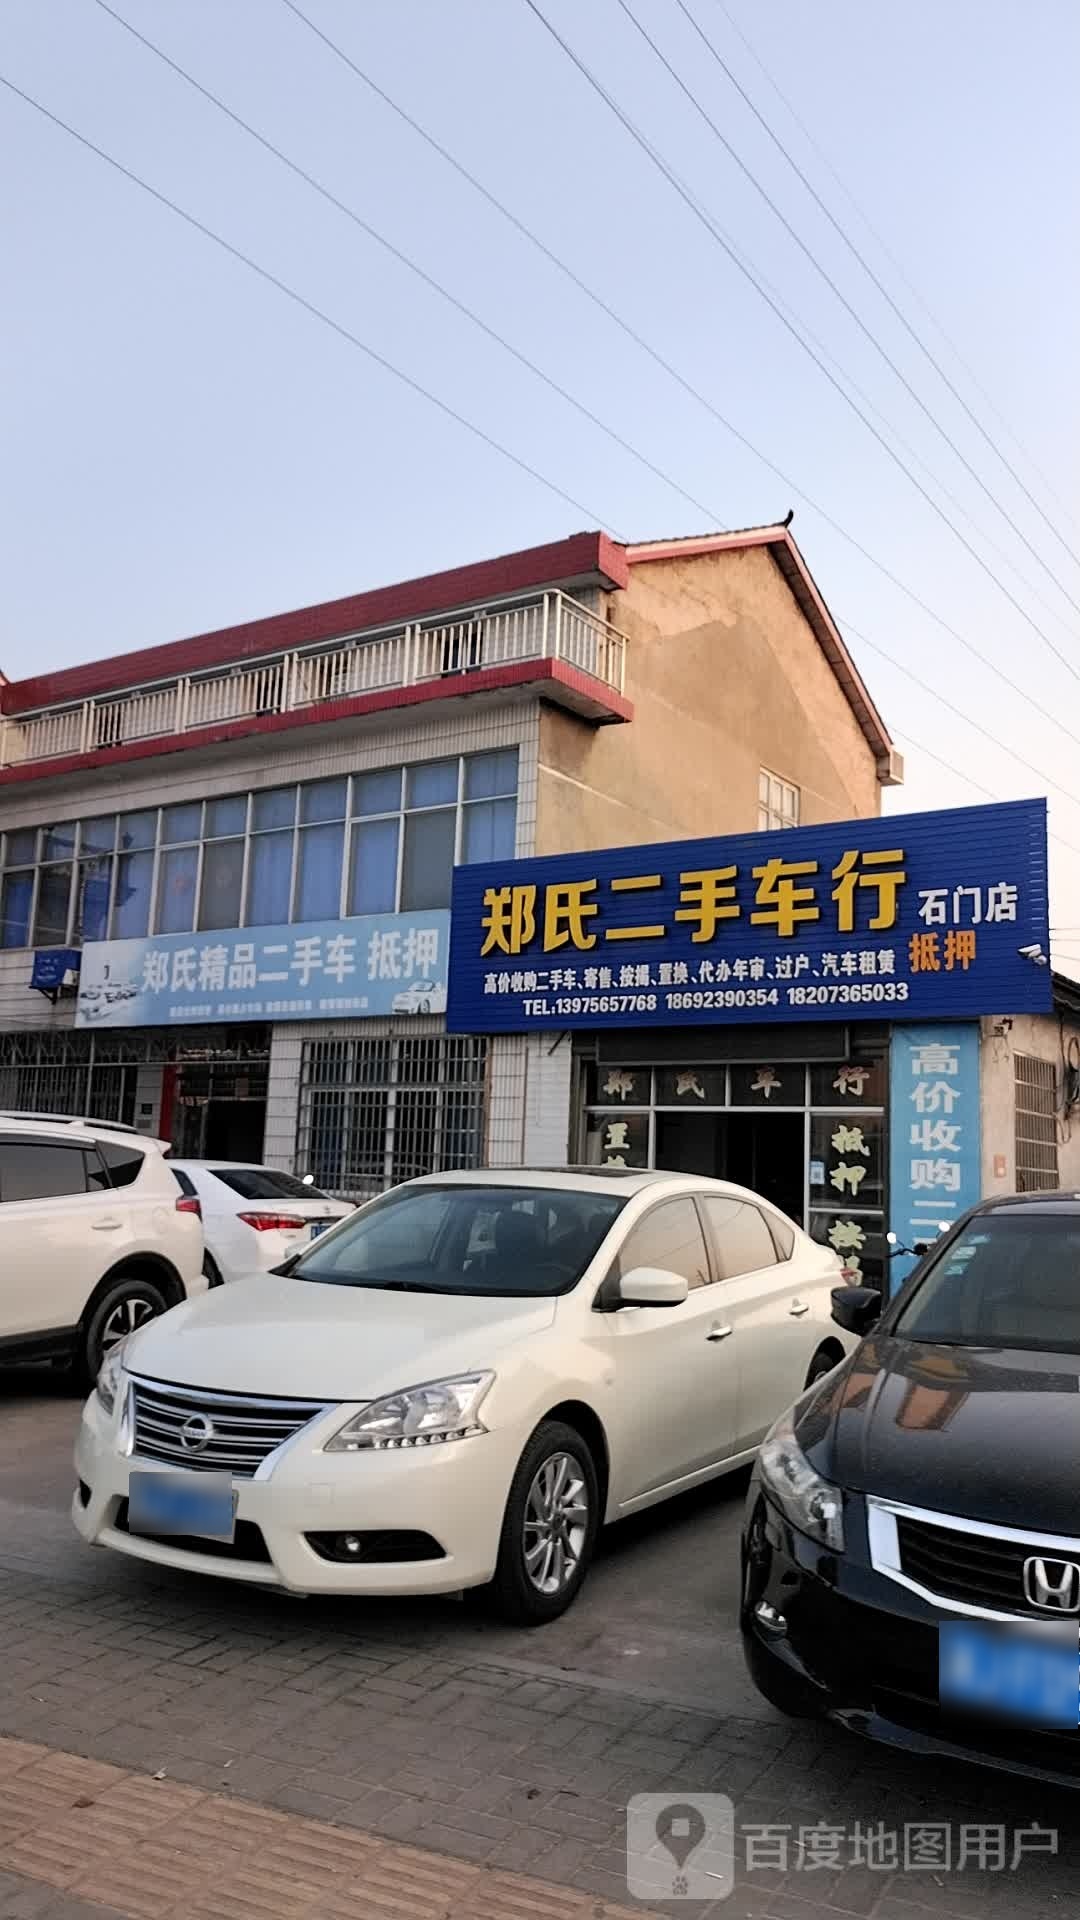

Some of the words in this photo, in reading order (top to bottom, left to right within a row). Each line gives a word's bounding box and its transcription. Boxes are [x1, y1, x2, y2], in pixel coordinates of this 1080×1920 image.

[480, 849, 906, 957] 郑氏二手车行
[918, 882, 1018, 925] 石门店
[141, 934, 357, 994] 郑氏精品二手车
[368, 928, 439, 981] 抵押
[908, 930, 976, 973] 抵押
[665, 988, 779, 1010] 18692390354
[786, 982, 909, 1006] 18207365033
